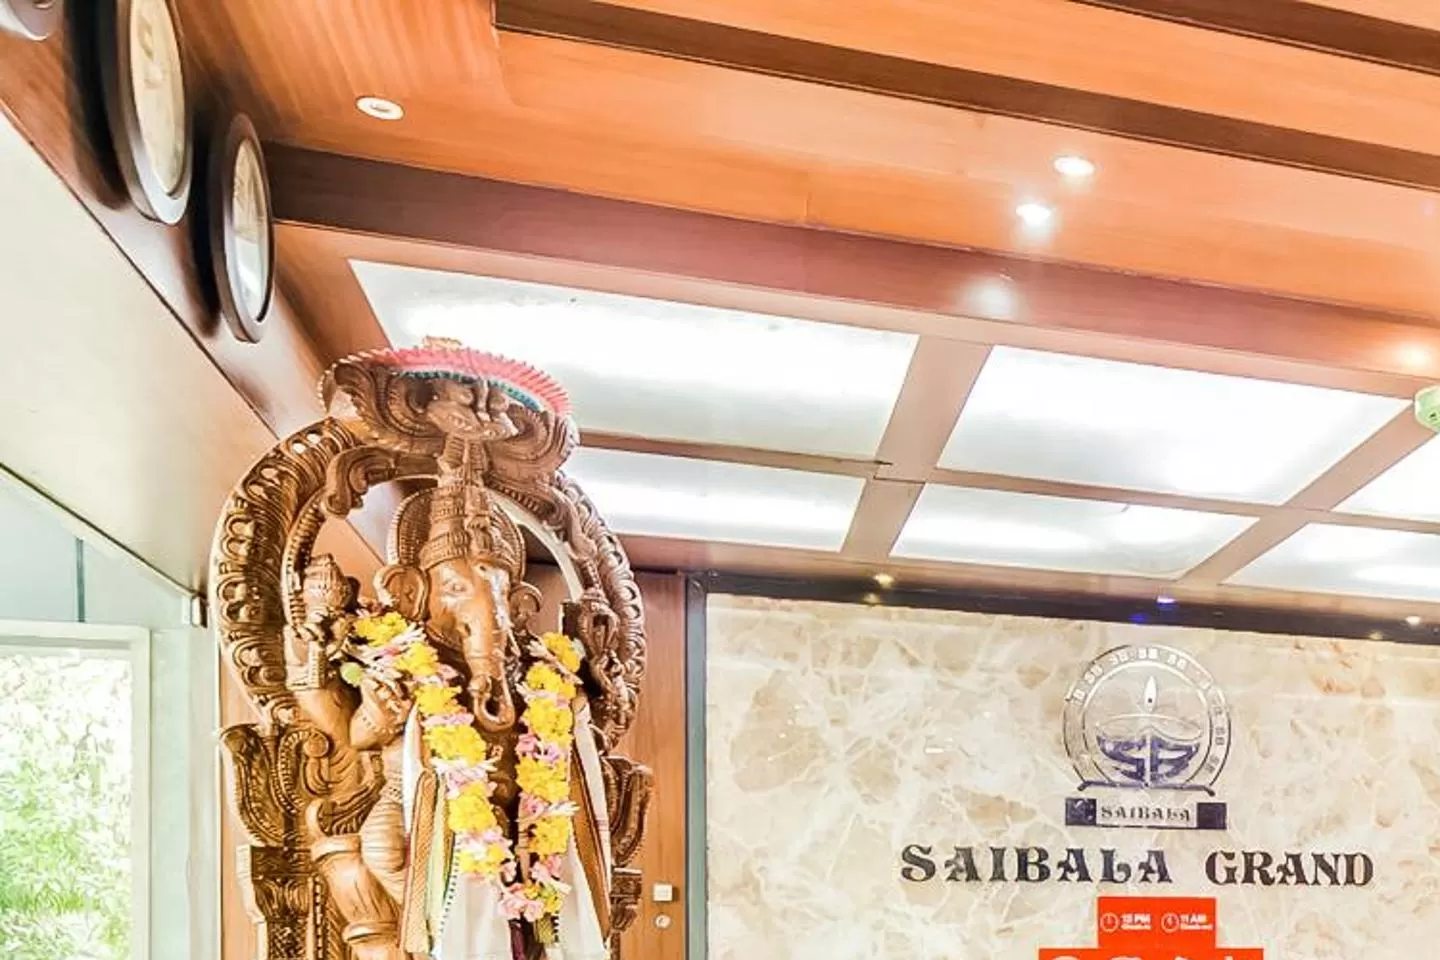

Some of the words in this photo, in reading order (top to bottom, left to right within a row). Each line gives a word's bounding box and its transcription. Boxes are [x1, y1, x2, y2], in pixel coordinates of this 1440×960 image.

[1101, 803, 1191, 822] SAIBALA
[900, 843, 1173, 884] SAIBALA
[1204, 851, 1375, 888] GRAND
